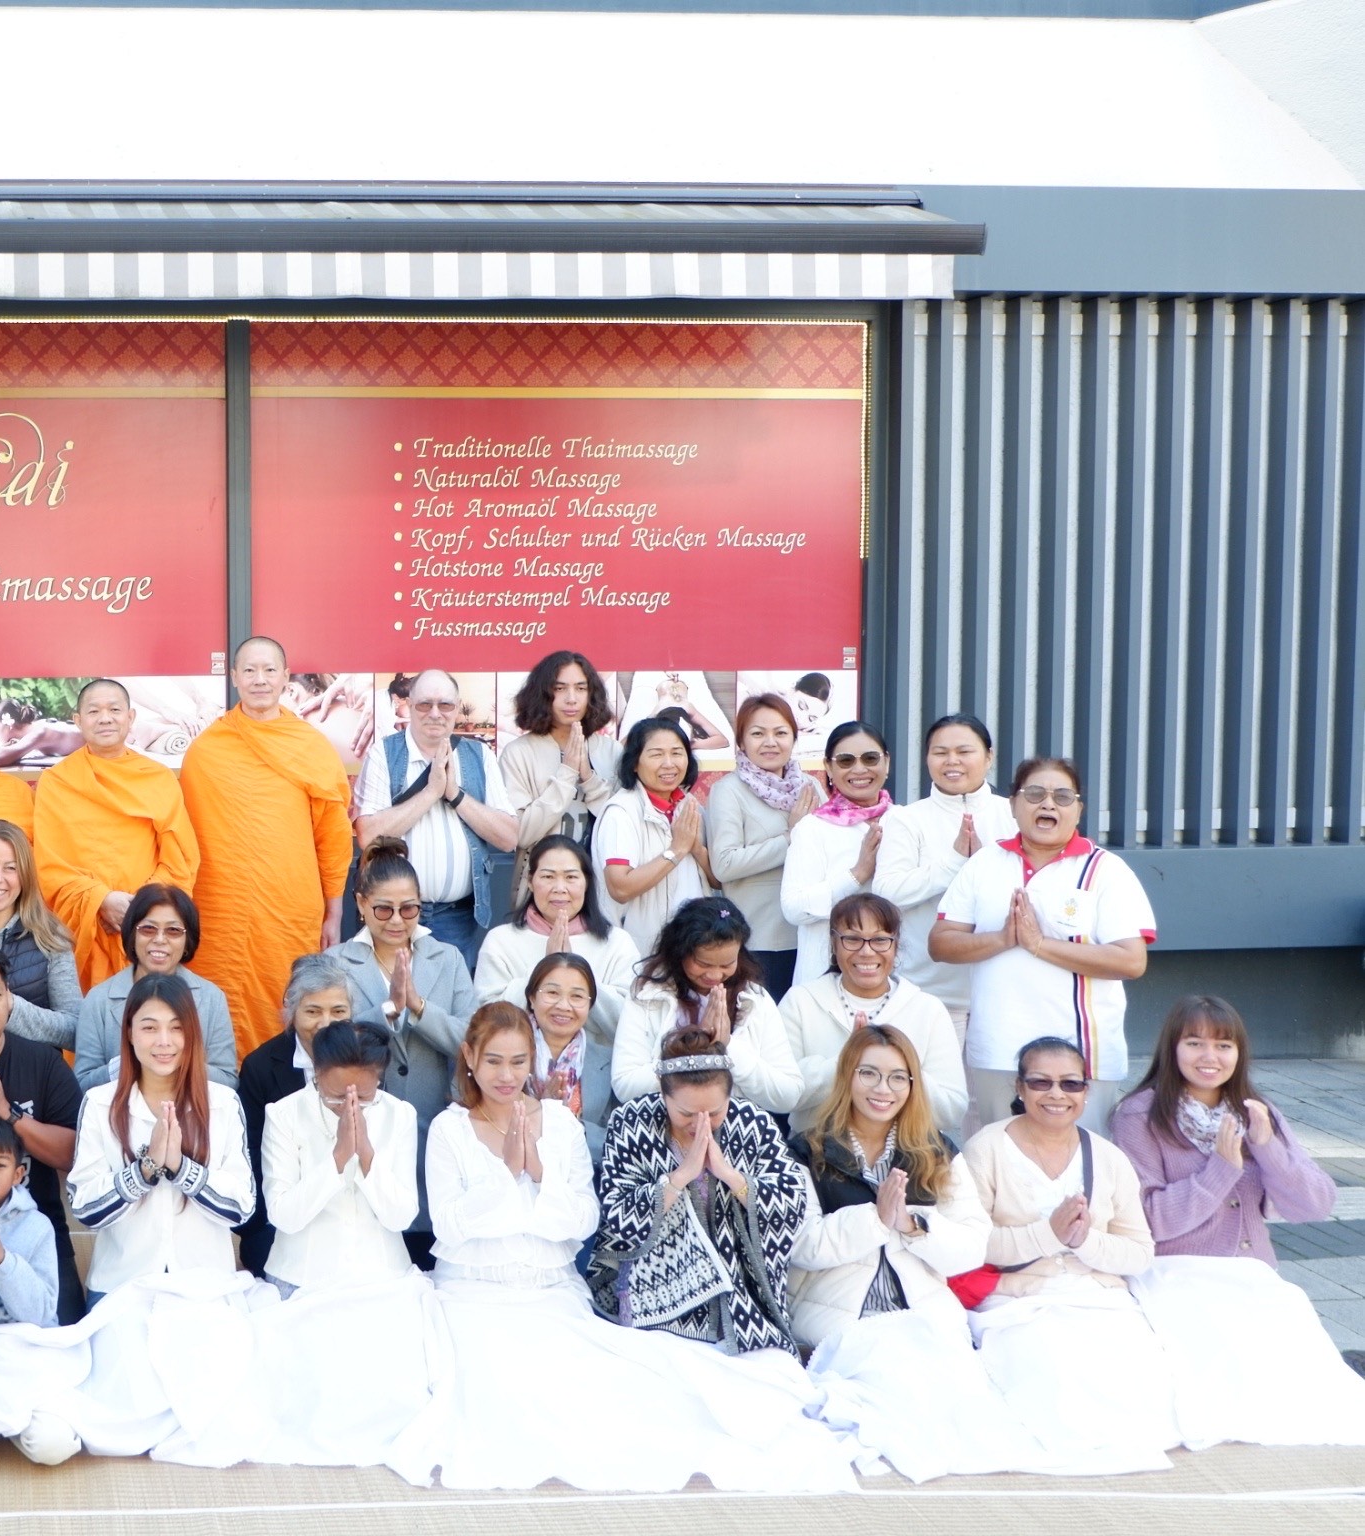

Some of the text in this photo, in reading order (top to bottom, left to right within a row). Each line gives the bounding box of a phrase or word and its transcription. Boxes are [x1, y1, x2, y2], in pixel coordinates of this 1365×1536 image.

[414, 436, 698, 465] Traditionelle Thaimassage
[413, 466, 621, 495] Naturalöl Massage
[412, 496, 657, 525] Hot Aromaöl Massage
[410, 526, 807, 555] Kopf, Schulter und Rücken Massage
[409, 557, 605, 585] Hotstone Massage
[411, 586, 671, 614] Kräuterstempel Massage
[413, 617, 547, 643] Fussmassage
